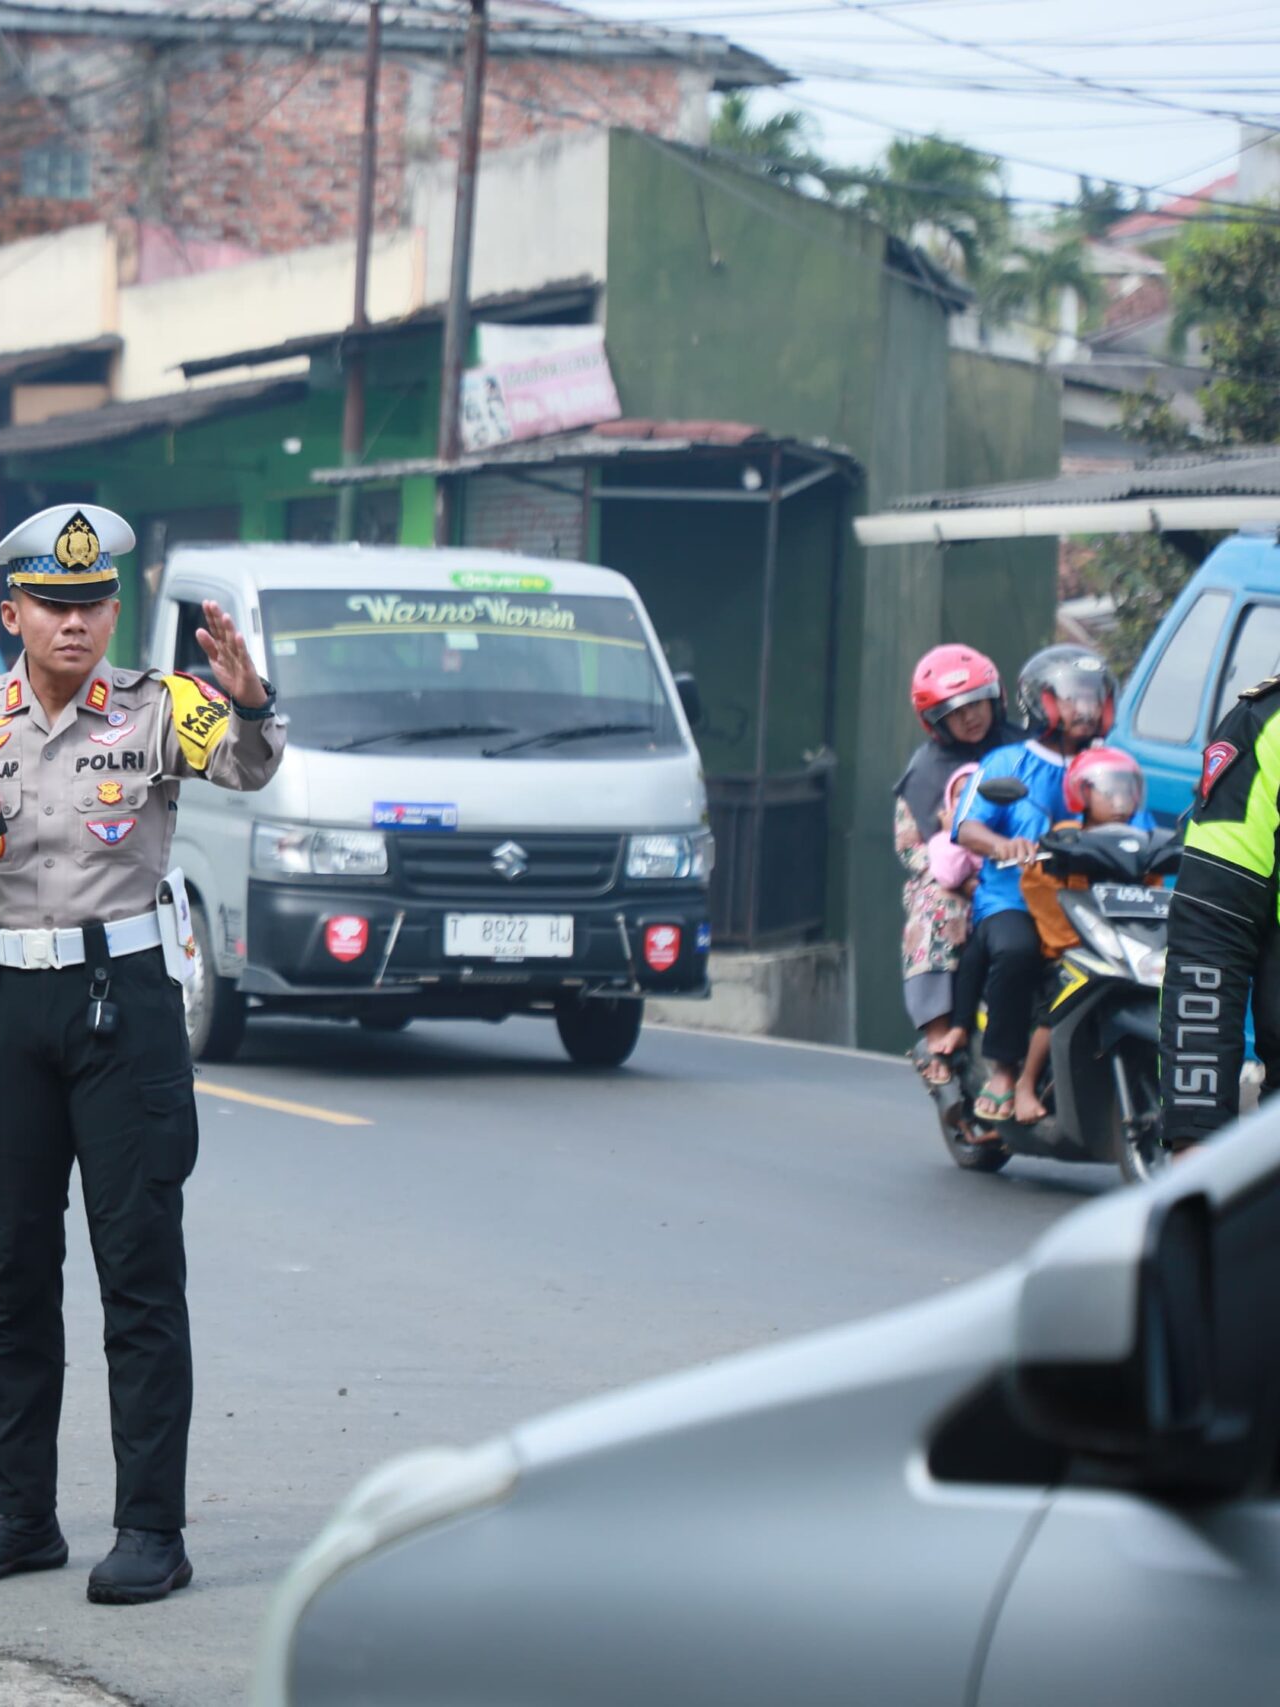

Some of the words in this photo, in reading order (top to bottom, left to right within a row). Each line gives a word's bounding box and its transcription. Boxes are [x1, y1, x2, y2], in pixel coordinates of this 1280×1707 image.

[75, 751, 144, 773] POLRI
[450, 919, 459, 941] T
[481, 919, 528, 942] 8922
[549, 920, 572, 943] HJ
[1173, 965, 1222, 1107] POLISI
